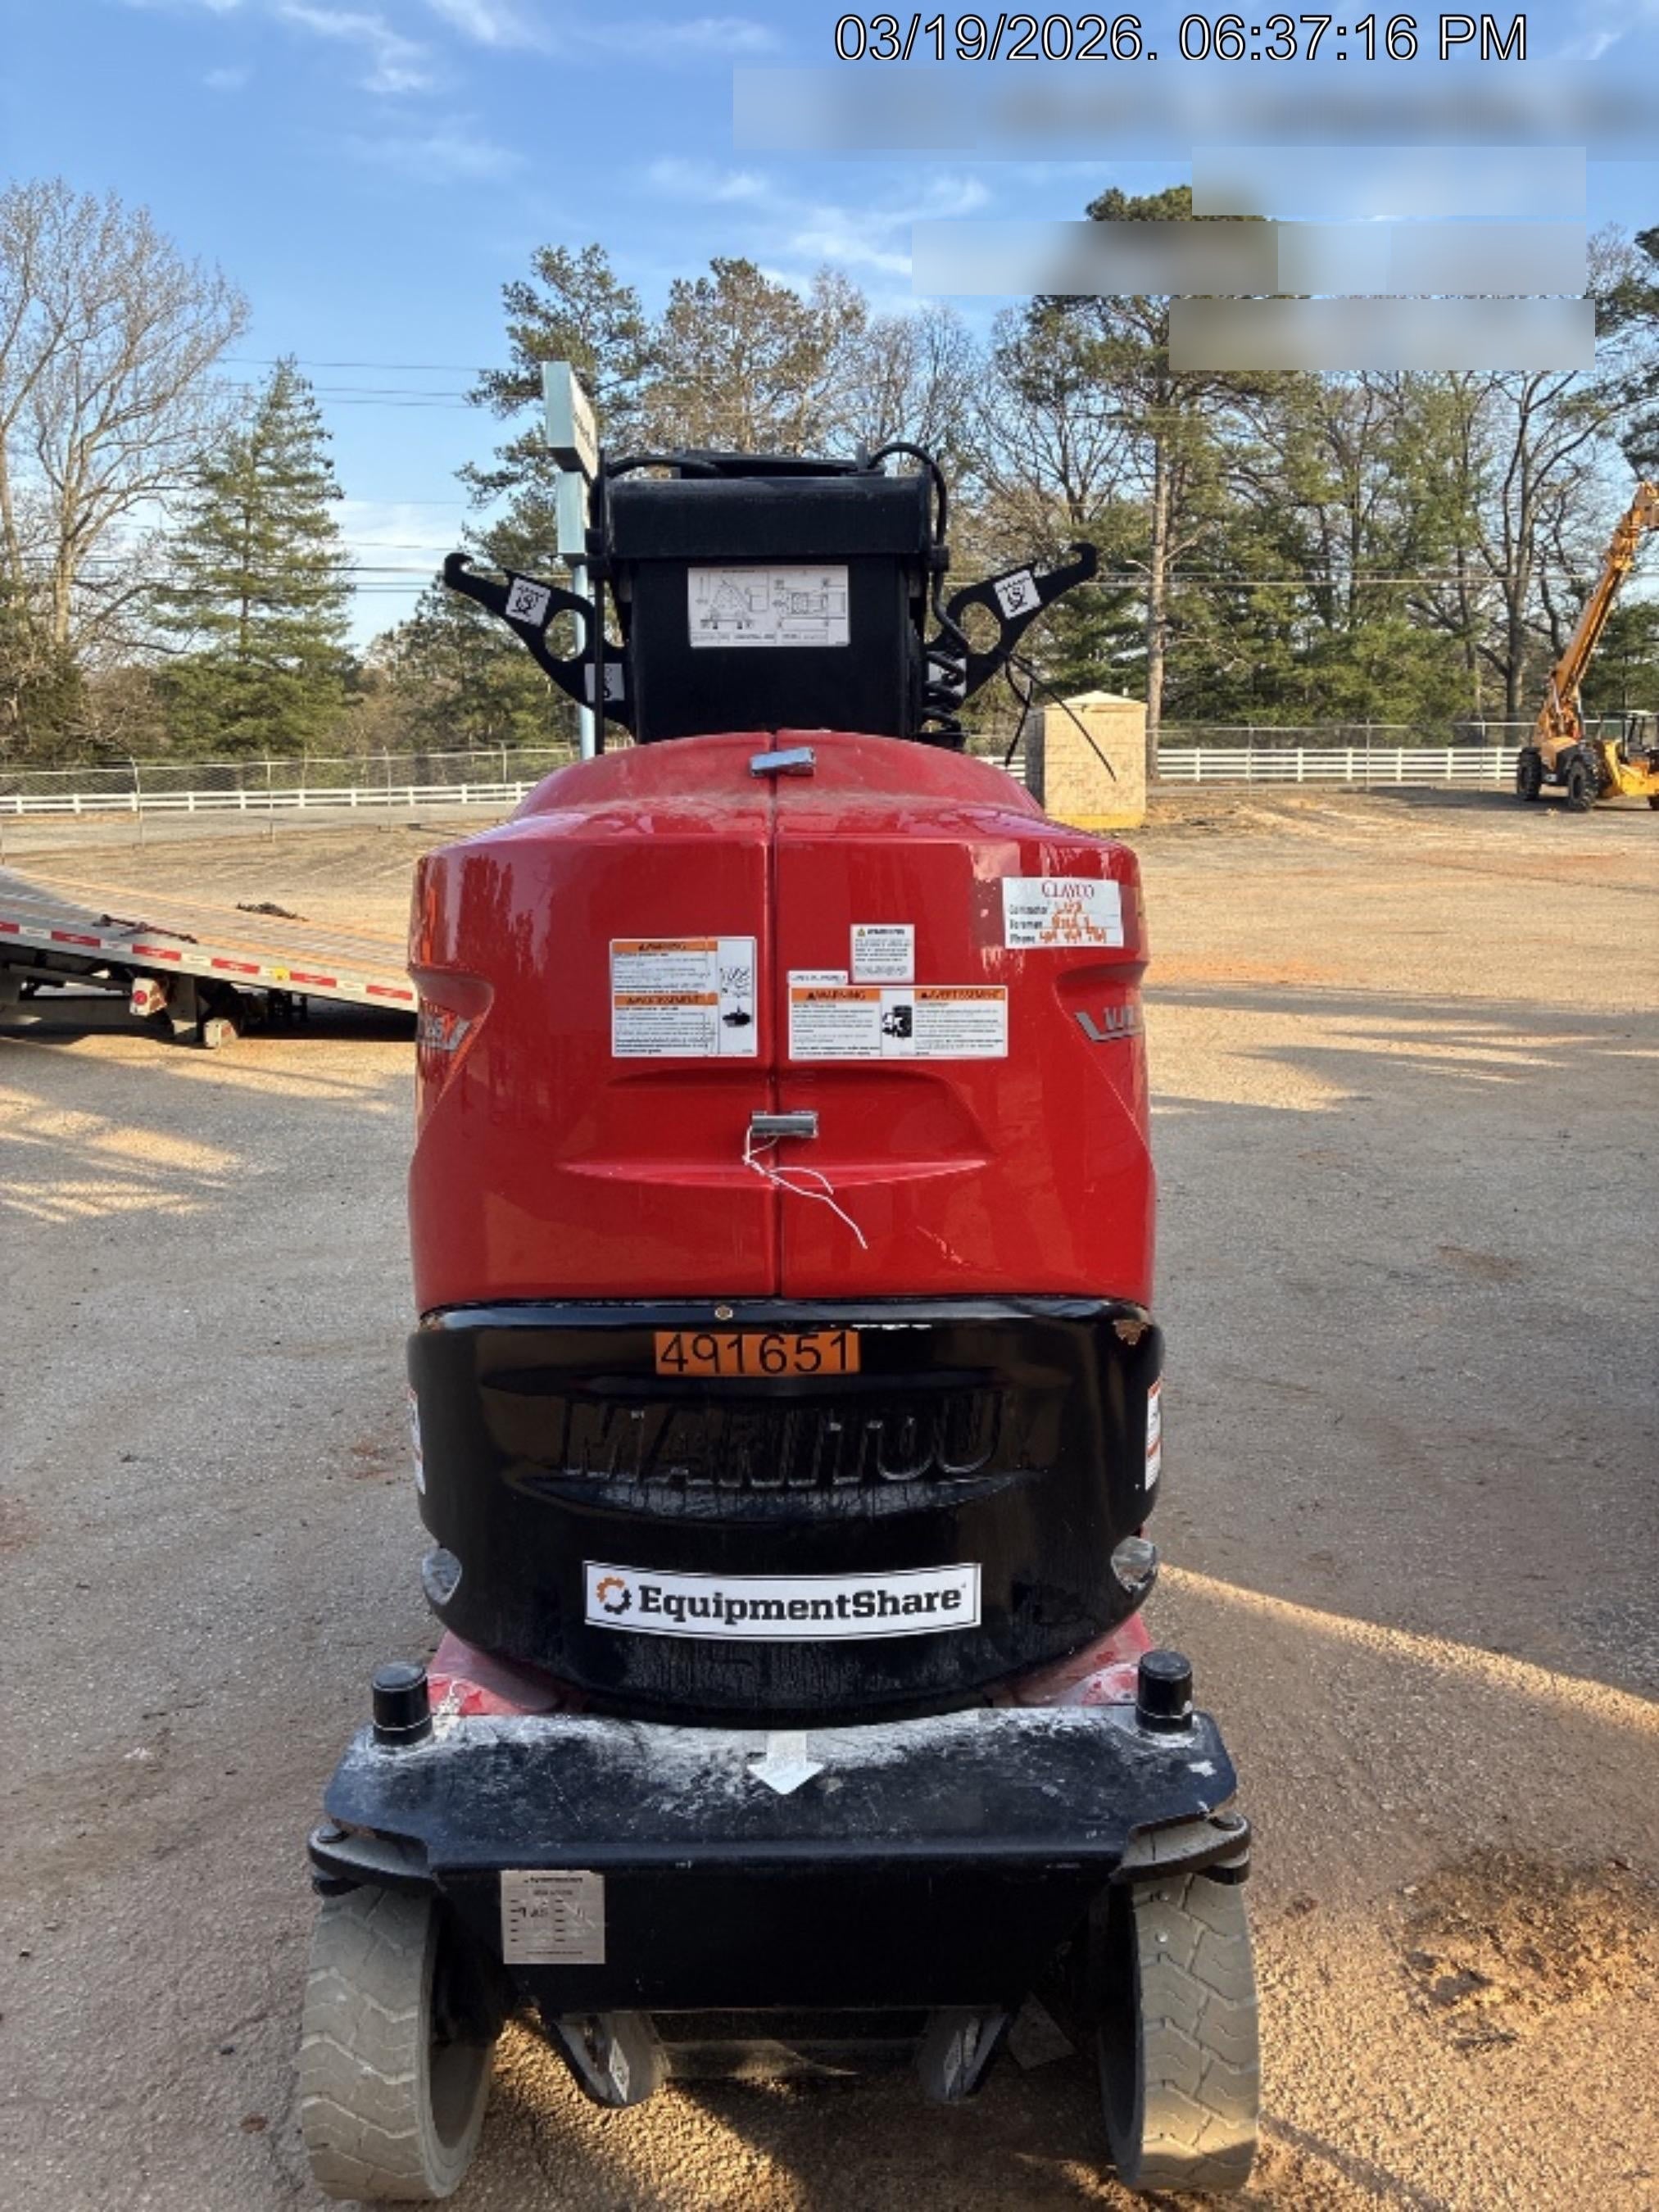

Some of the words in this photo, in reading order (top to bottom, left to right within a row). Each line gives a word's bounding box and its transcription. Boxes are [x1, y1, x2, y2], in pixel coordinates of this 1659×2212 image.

[1041, 880, 1095, 900] CLAYCO
[660, 1332, 850, 1374] 491651
[639, 1585, 962, 1625] EquipmentShare
